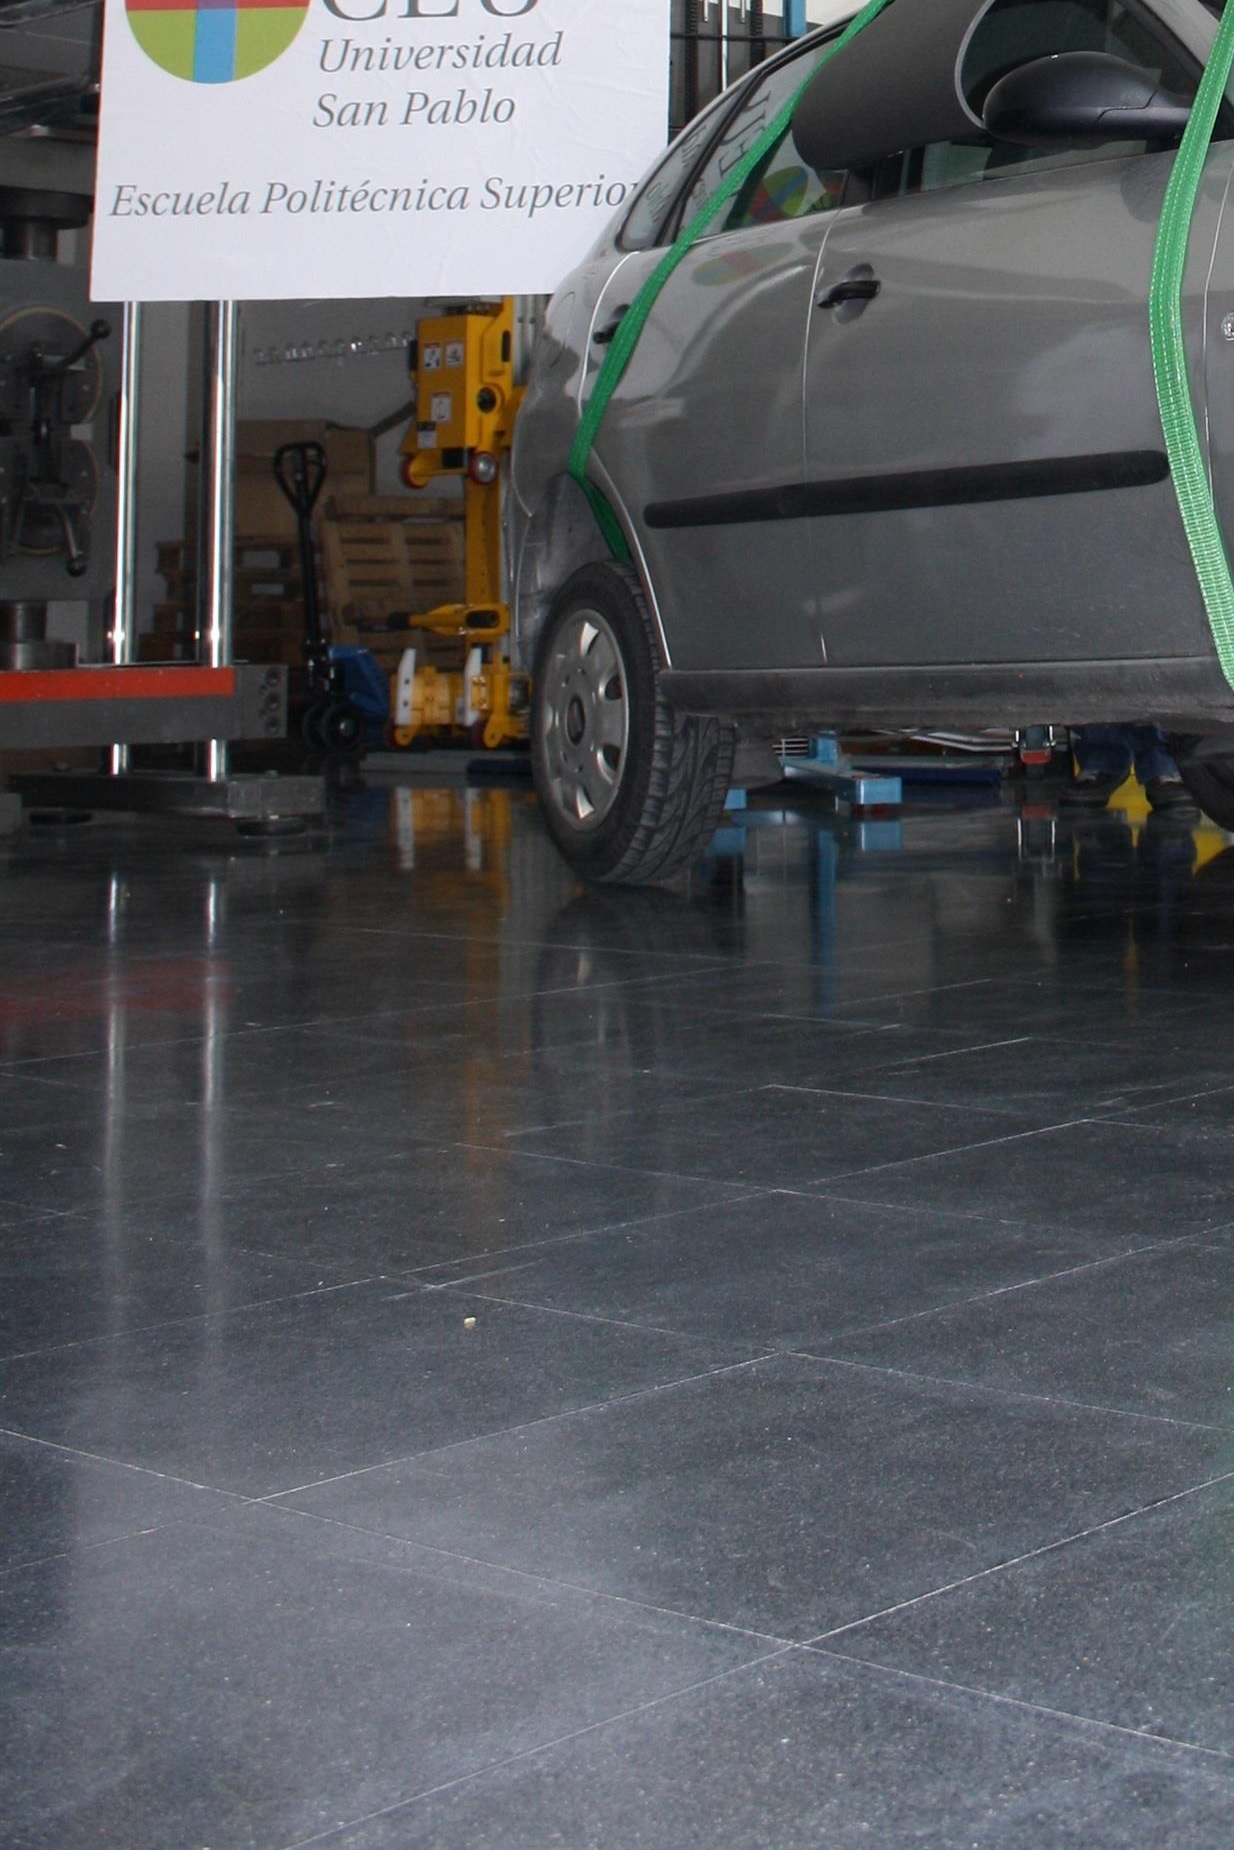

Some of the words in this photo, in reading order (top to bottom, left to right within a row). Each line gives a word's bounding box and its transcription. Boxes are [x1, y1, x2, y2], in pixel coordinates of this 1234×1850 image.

[318, 31, 564, 74] Universidad
[312, 92, 389, 128] San
[399, 89, 516, 127] Pablo
[108, 182, 250, 218] Escuela
[260, 177, 470, 215] Politécnica
